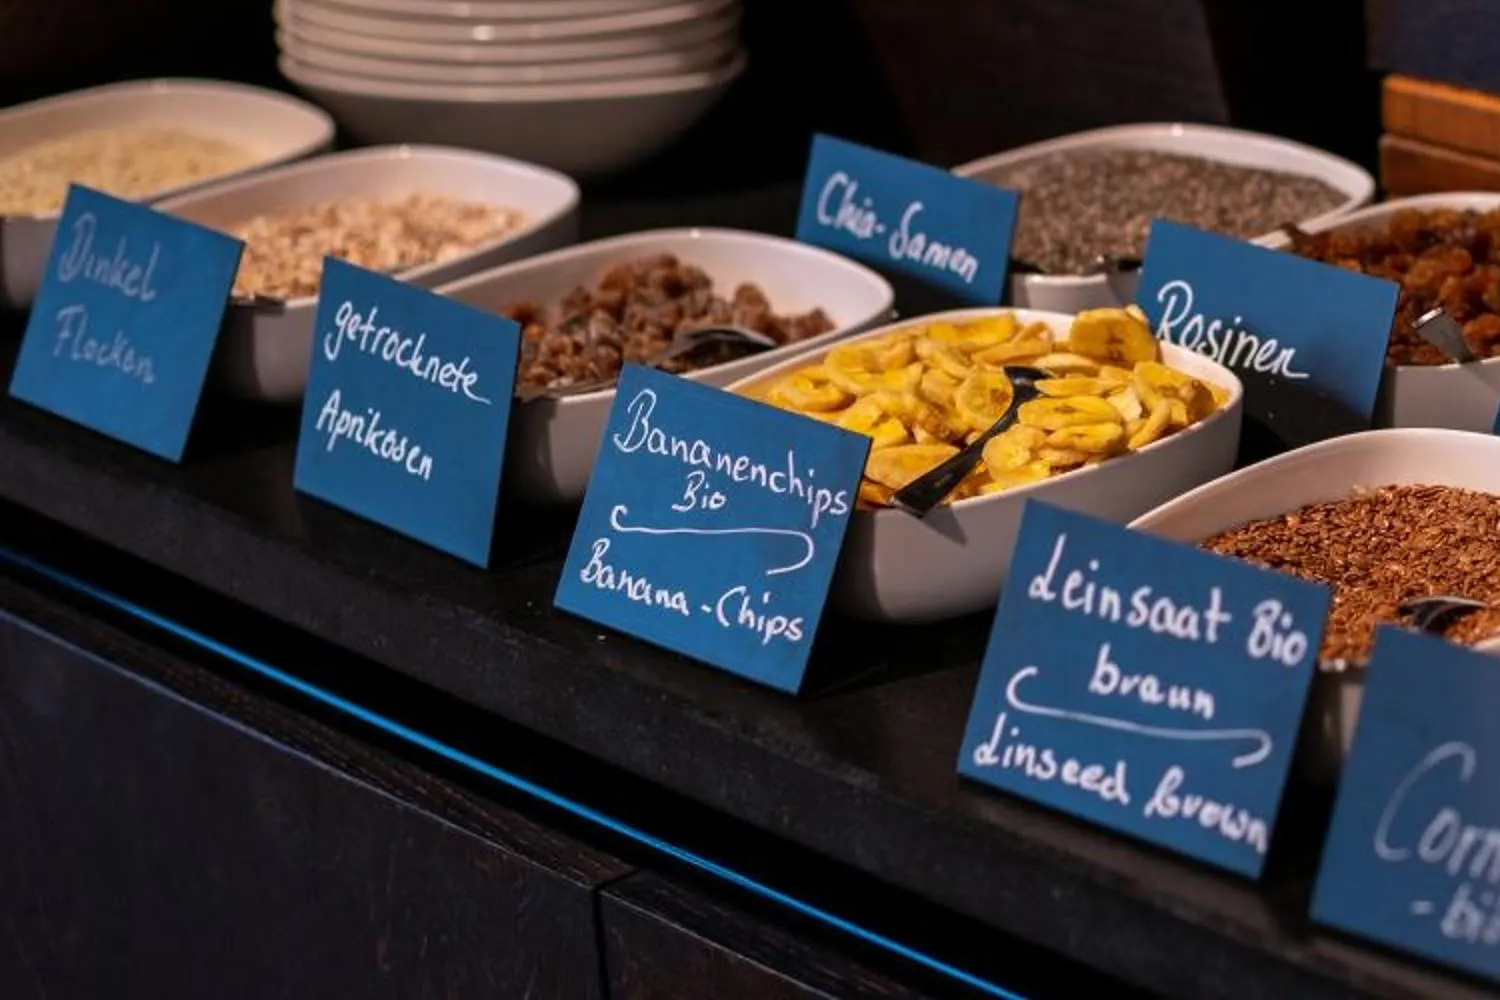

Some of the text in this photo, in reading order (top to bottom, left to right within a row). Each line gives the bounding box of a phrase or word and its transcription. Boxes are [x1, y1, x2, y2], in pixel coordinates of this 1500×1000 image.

[58, 212, 161, 301] Dinkel
[53, 304, 155, 384] Flocken
[323, 300, 492, 406] getrocknete
[1156, 280, 1310, 379] Rosinen
[315, 389, 433, 480] Aprikosen
[613, 388, 849, 528] Bananenchips
[671, 470, 728, 512] Bio
[1027, 533, 1308, 666] Leinsaat Bio
[1088, 642, 1216, 719] braun
[973, 712, 1131, 805] Linseed
